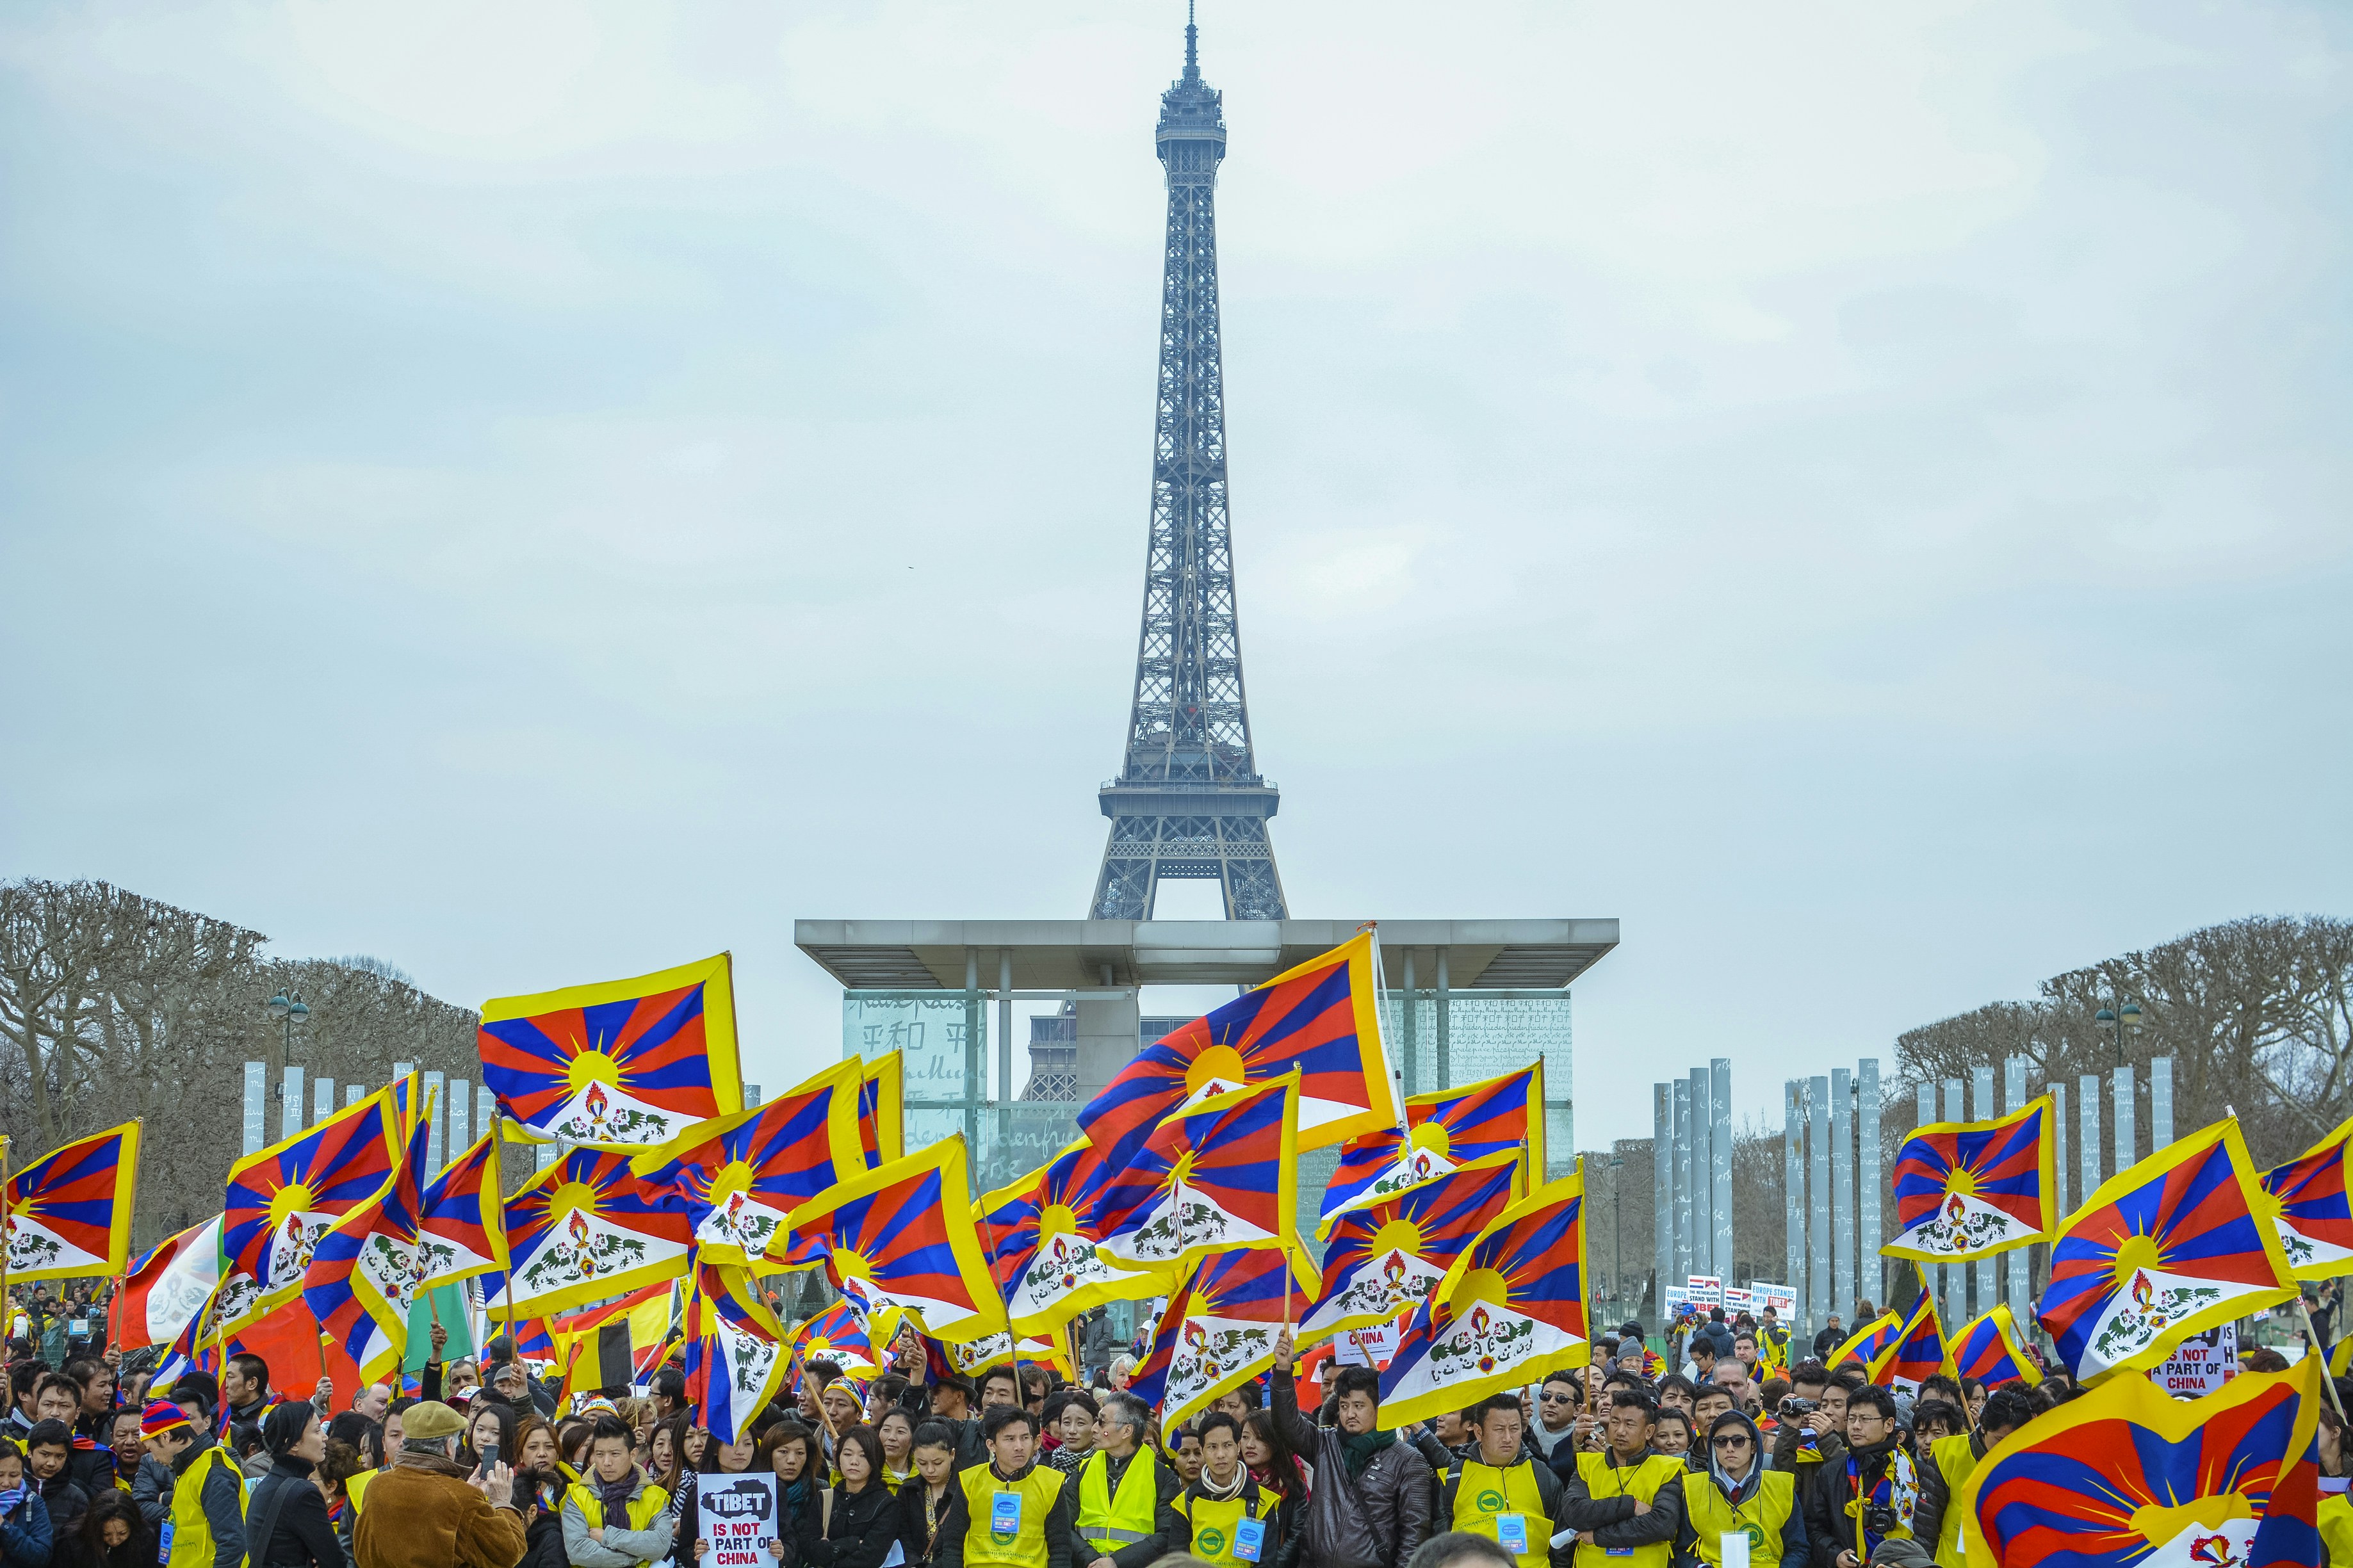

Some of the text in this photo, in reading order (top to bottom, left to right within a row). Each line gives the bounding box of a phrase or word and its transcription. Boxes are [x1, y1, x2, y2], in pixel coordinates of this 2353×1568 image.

[1667, 1289, 1686, 1298] EUROPE
[1753, 1286, 1794, 1298] EUROPE STANDS
[1752, 1295, 1786, 1307] WITH TIBET.
[1349, 1331, 1384, 1346] CHINA
[2183, 1349, 2209, 1361] NOT
[2153, 1363, 2221, 1375] A PART OF
[2167, 1377, 2206, 1389] CHINA
[711, 1492, 766, 1512] TIBET
[713, 1522, 761, 1536] IS NOT
[715, 1537, 753, 1551] PART
[717, 1552, 758, 1565] CHINA
